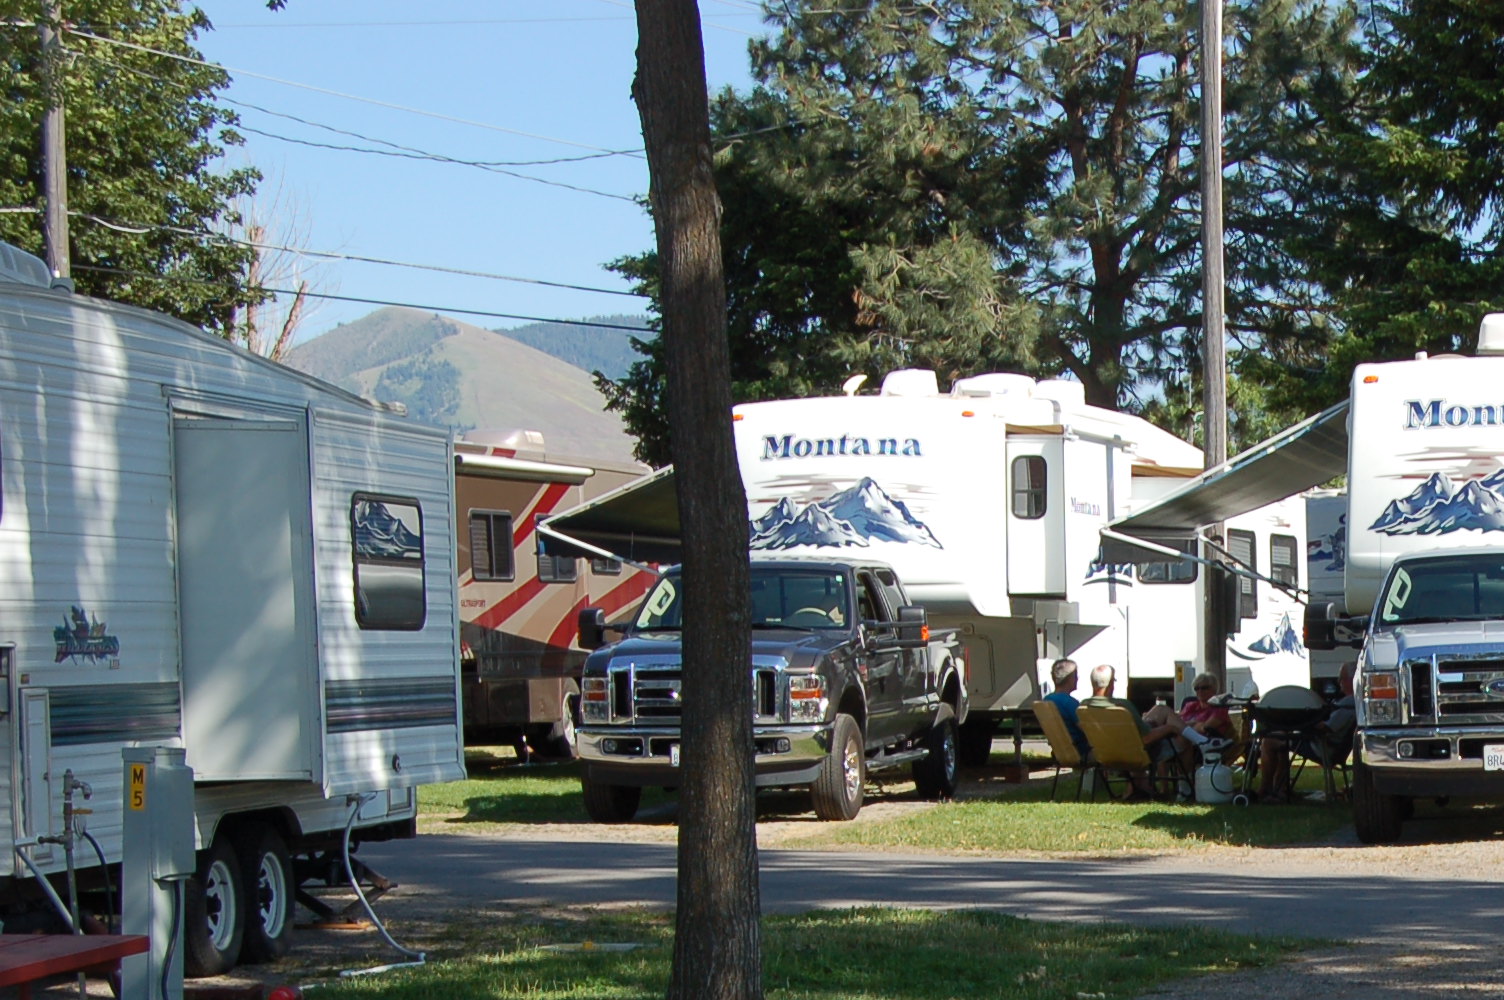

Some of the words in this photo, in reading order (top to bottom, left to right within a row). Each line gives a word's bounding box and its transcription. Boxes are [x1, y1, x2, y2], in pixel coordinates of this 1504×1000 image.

[760, 432, 923, 461] Montana
[133, 767, 144, 785] M
[134, 790, 142, 807] 5
